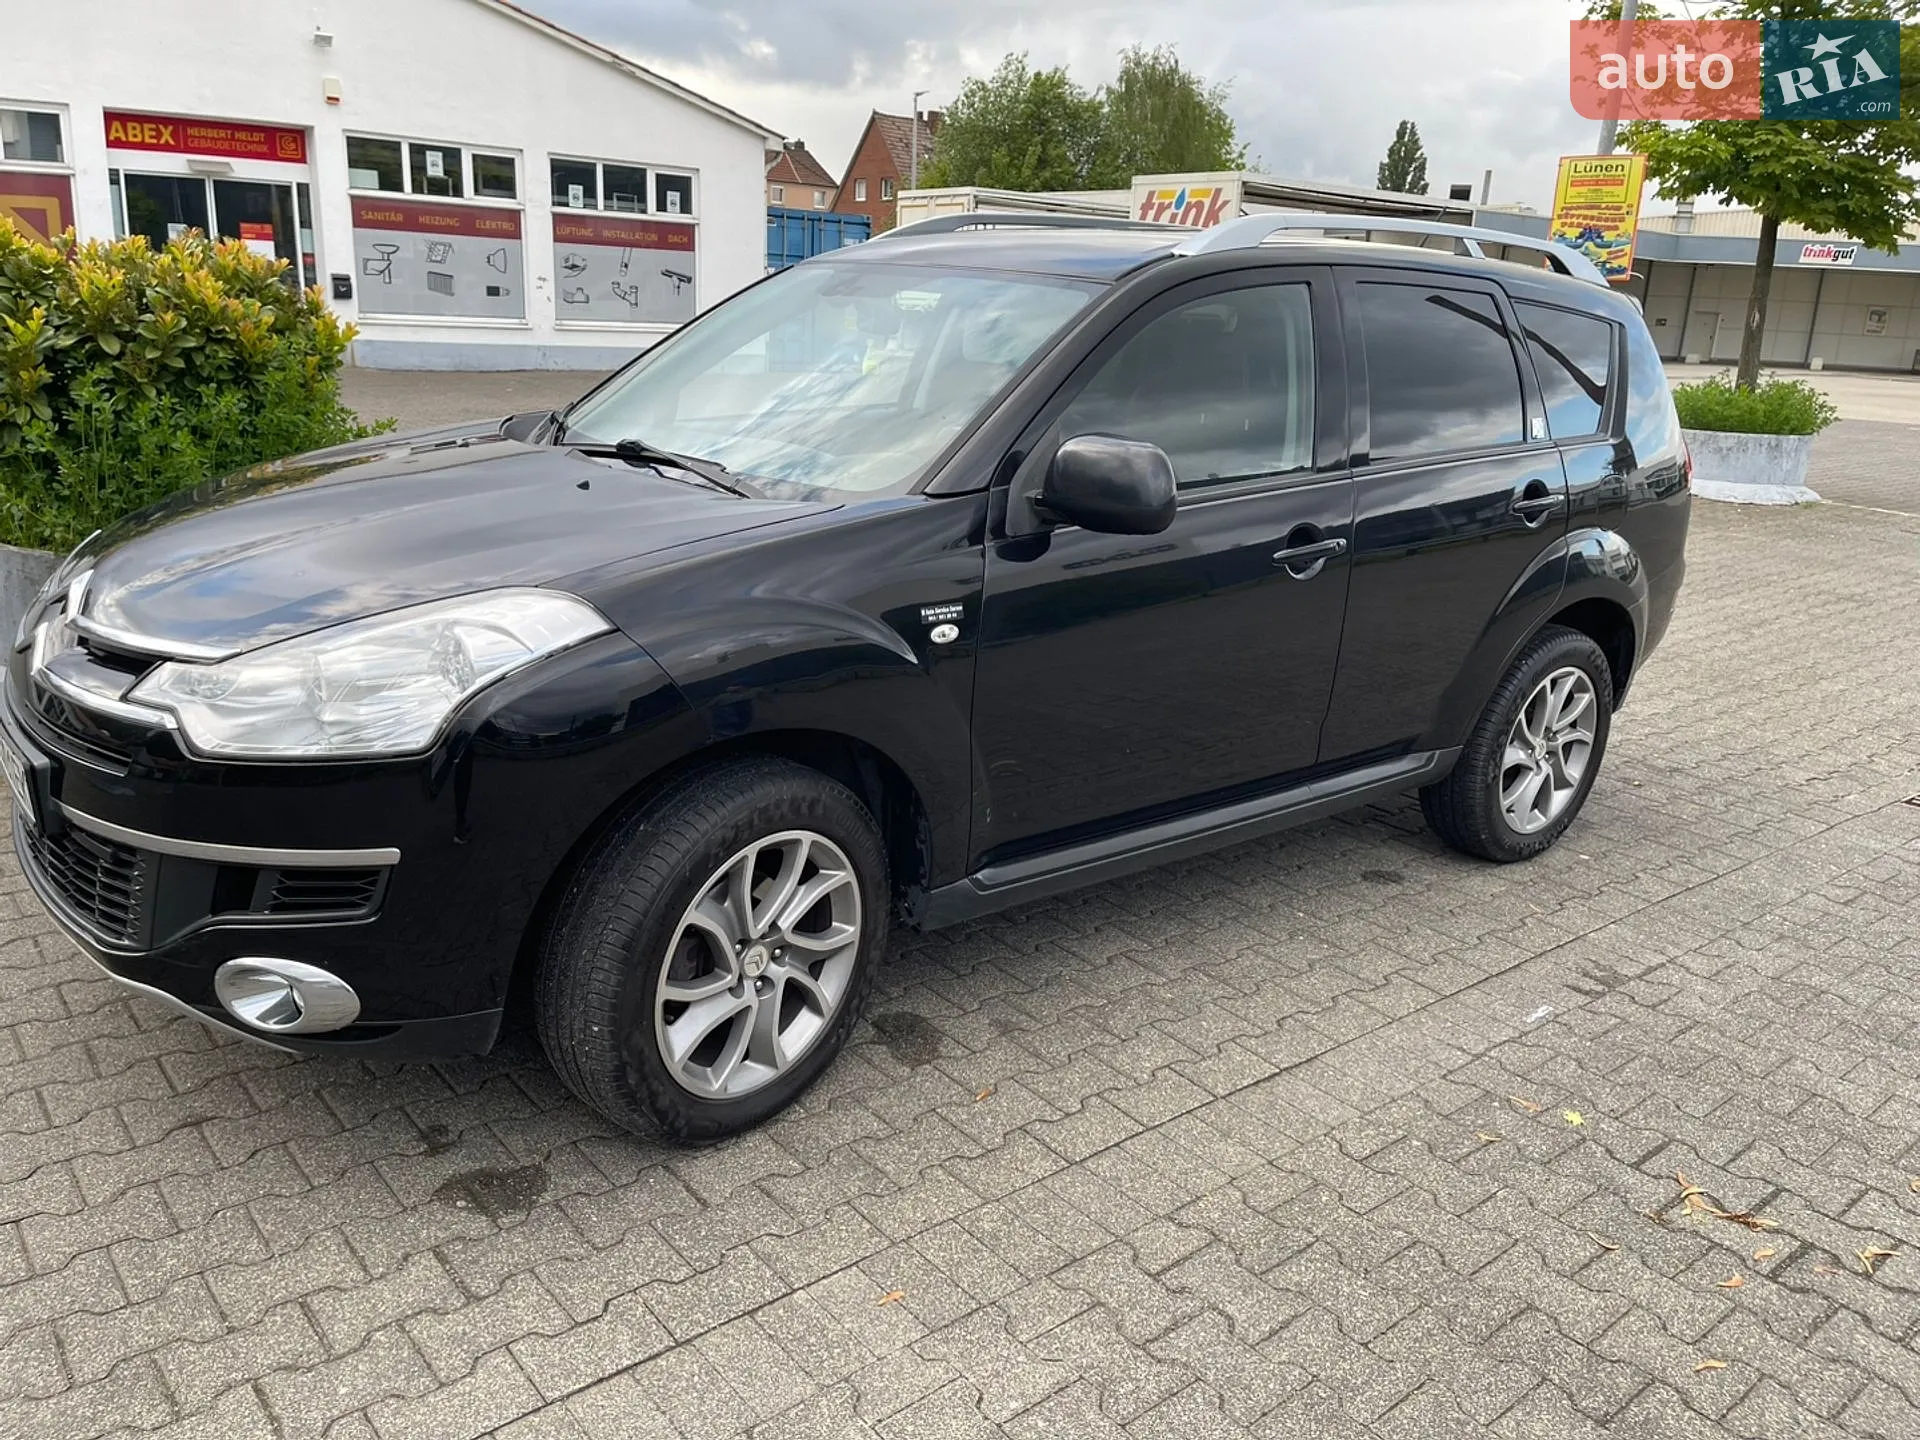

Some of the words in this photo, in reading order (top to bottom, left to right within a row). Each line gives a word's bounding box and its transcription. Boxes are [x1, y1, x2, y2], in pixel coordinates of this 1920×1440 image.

[109, 120, 177, 146] ABEX
[186, 127, 233, 139] HERBERT
[235, 130, 265, 142] HELDT
[1573, 162, 1625, 174] Lünen
[360, 209, 404, 223] SANITÄR
[418, 214, 460, 227] HEIZUNG
[475, 219, 515, 231] ELEKTRO
[556, 225, 594, 237] LÜFTUNG
[603, 229, 659, 241] INSTALLATION
[667, 233, 689, 244] DACH
[1803, 245, 1856, 262] trinkgut
